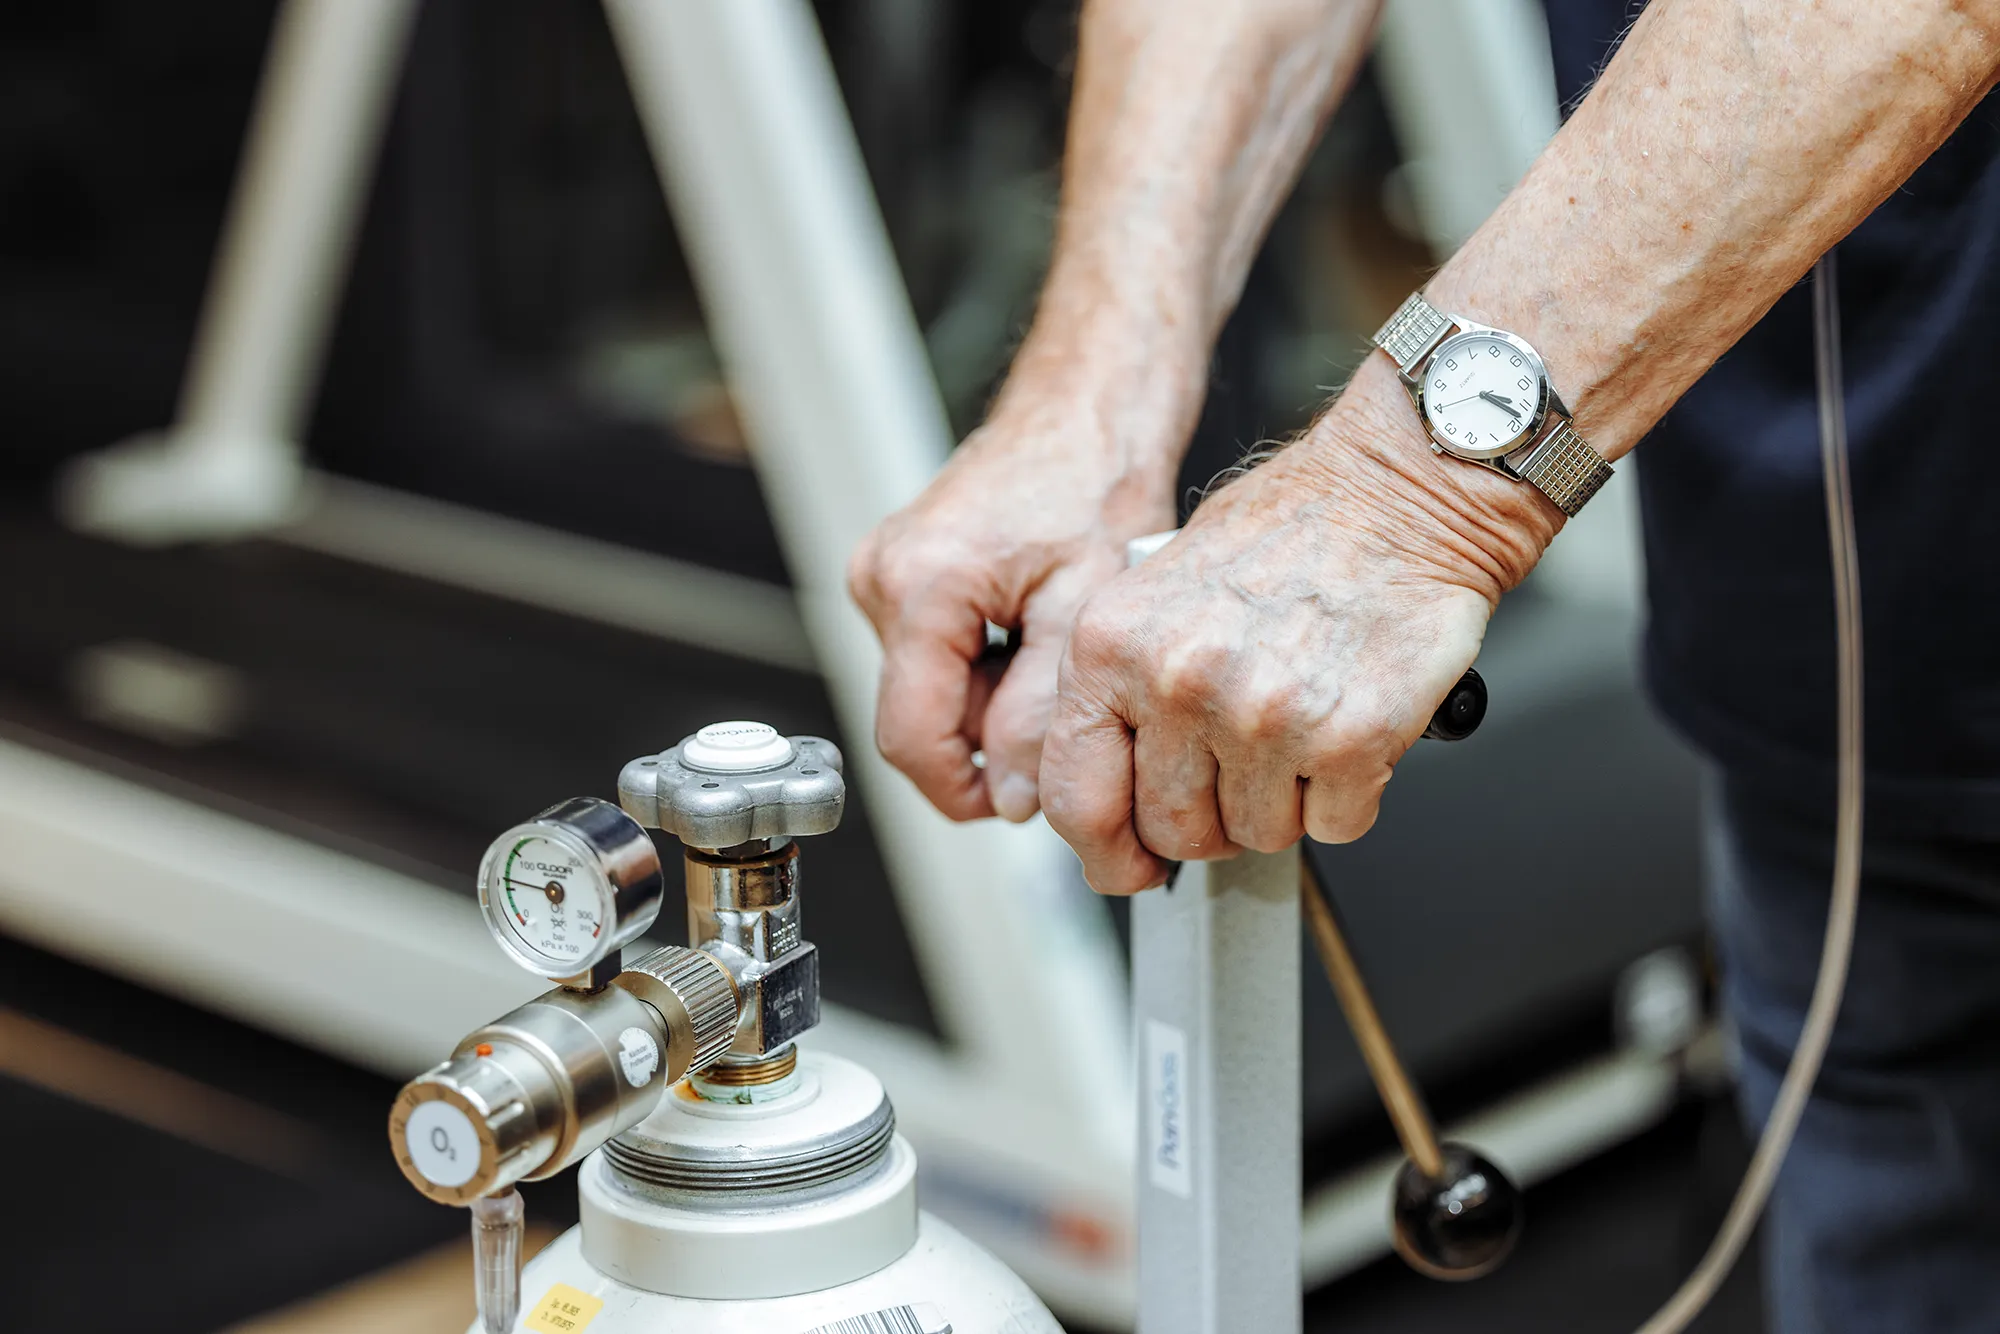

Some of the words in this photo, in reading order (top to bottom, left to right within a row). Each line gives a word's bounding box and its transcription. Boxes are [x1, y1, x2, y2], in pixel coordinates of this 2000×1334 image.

[1468, 347, 1478, 360] 7
[1488, 345, 1501, 358] 8
[1445, 358, 1458, 371] 6
[1509, 354, 1523, 368] 9
[1434, 378, 1447, 392] 5
[1459, 371, 1476, 389] QUARTZ
[1517, 375, 1533, 391] 10
[1433, 403, 1443, 414] 4
[1519, 398, 1532, 412] 11
[1444, 422, 1457, 436] 3
[1506, 416, 1523, 433] 12
[1464, 431, 1478, 445] 2
[1489, 433, 1499, 442] 1
[705, 727, 772, 737] PanGas
[520, 860, 535, 871] 100
[523, 908, 530, 918] 0
[577, 909, 593, 921] 300
[552, 932, 566, 941] bar
[541, 940, 556, 951] kPa
[565, 944, 580, 954] 100
